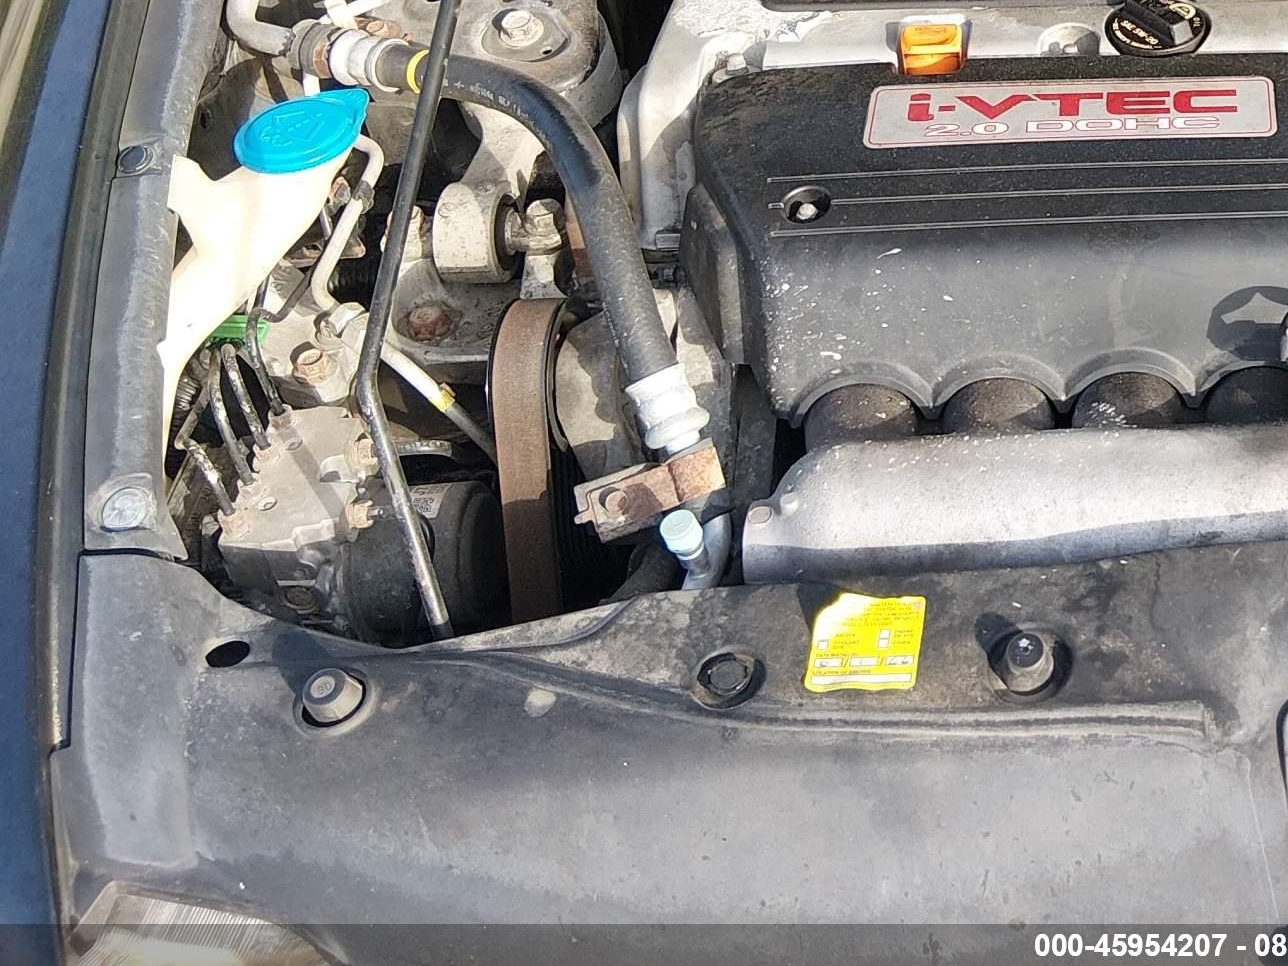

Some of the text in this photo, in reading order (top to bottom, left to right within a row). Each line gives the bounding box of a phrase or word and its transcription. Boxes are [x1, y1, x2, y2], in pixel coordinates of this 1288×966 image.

[907, 90, 1238, 123] i-VTEC
[923, 116, 1221, 137] 2.0 DOHC
